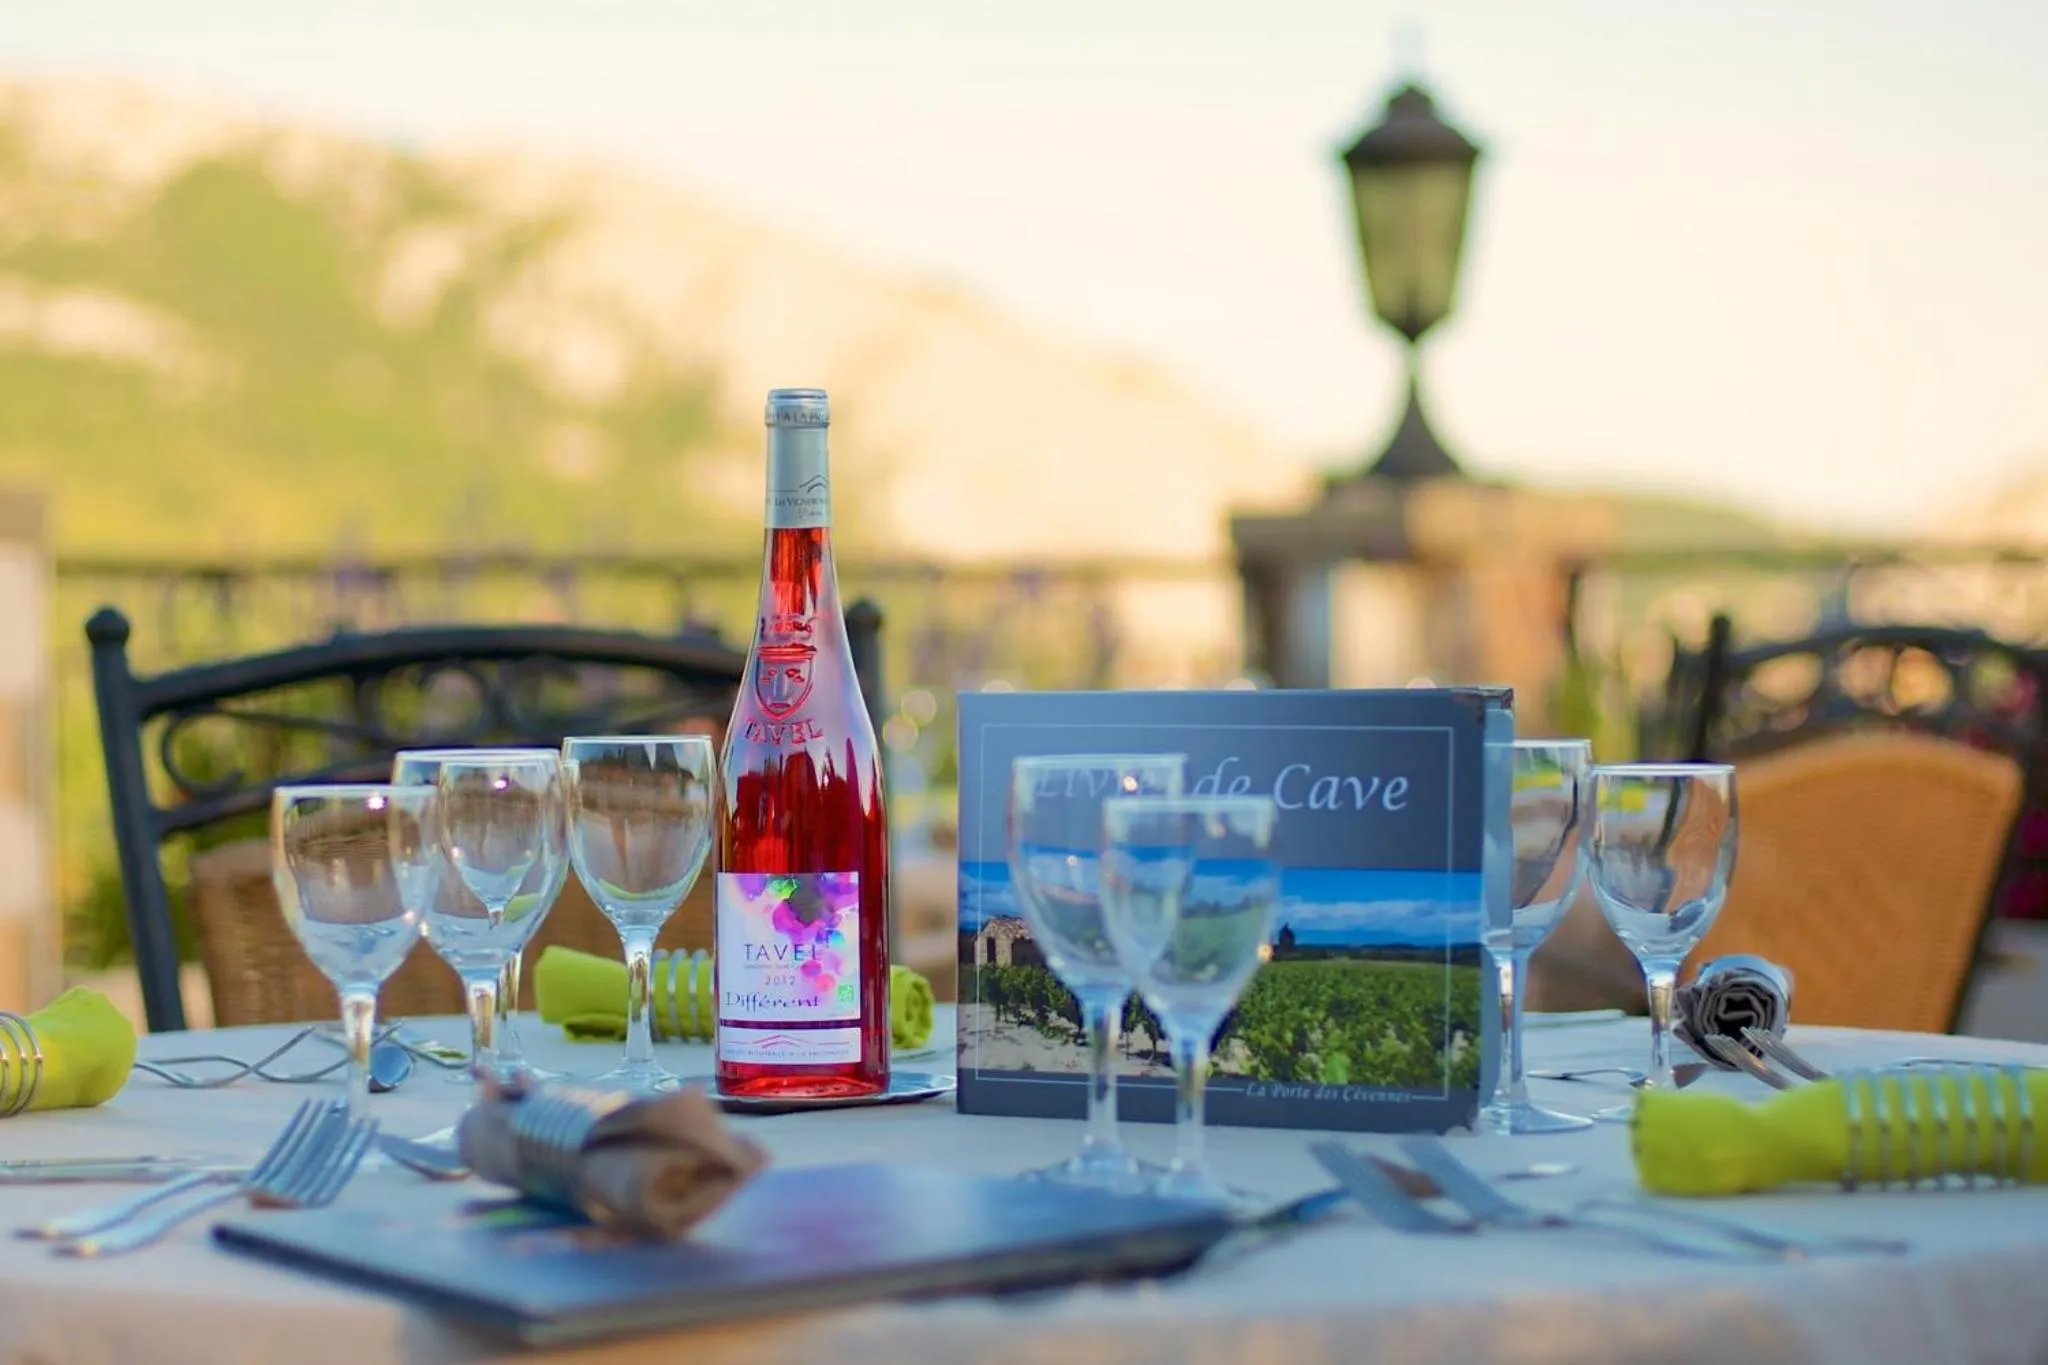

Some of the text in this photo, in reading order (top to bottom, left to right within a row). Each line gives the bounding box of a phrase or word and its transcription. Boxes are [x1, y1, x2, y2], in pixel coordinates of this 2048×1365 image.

[744, 718, 824, 745] TAVEL
[1193, 756, 1251, 802] de
[1273, 763, 1409, 812] Cave
[743, 943, 819, 961] TAVEL
[1246, 1082, 1266, 1097] La
[1271, 1083, 1312, 1099] Porte
[1314, 1084, 1338, 1100] des
